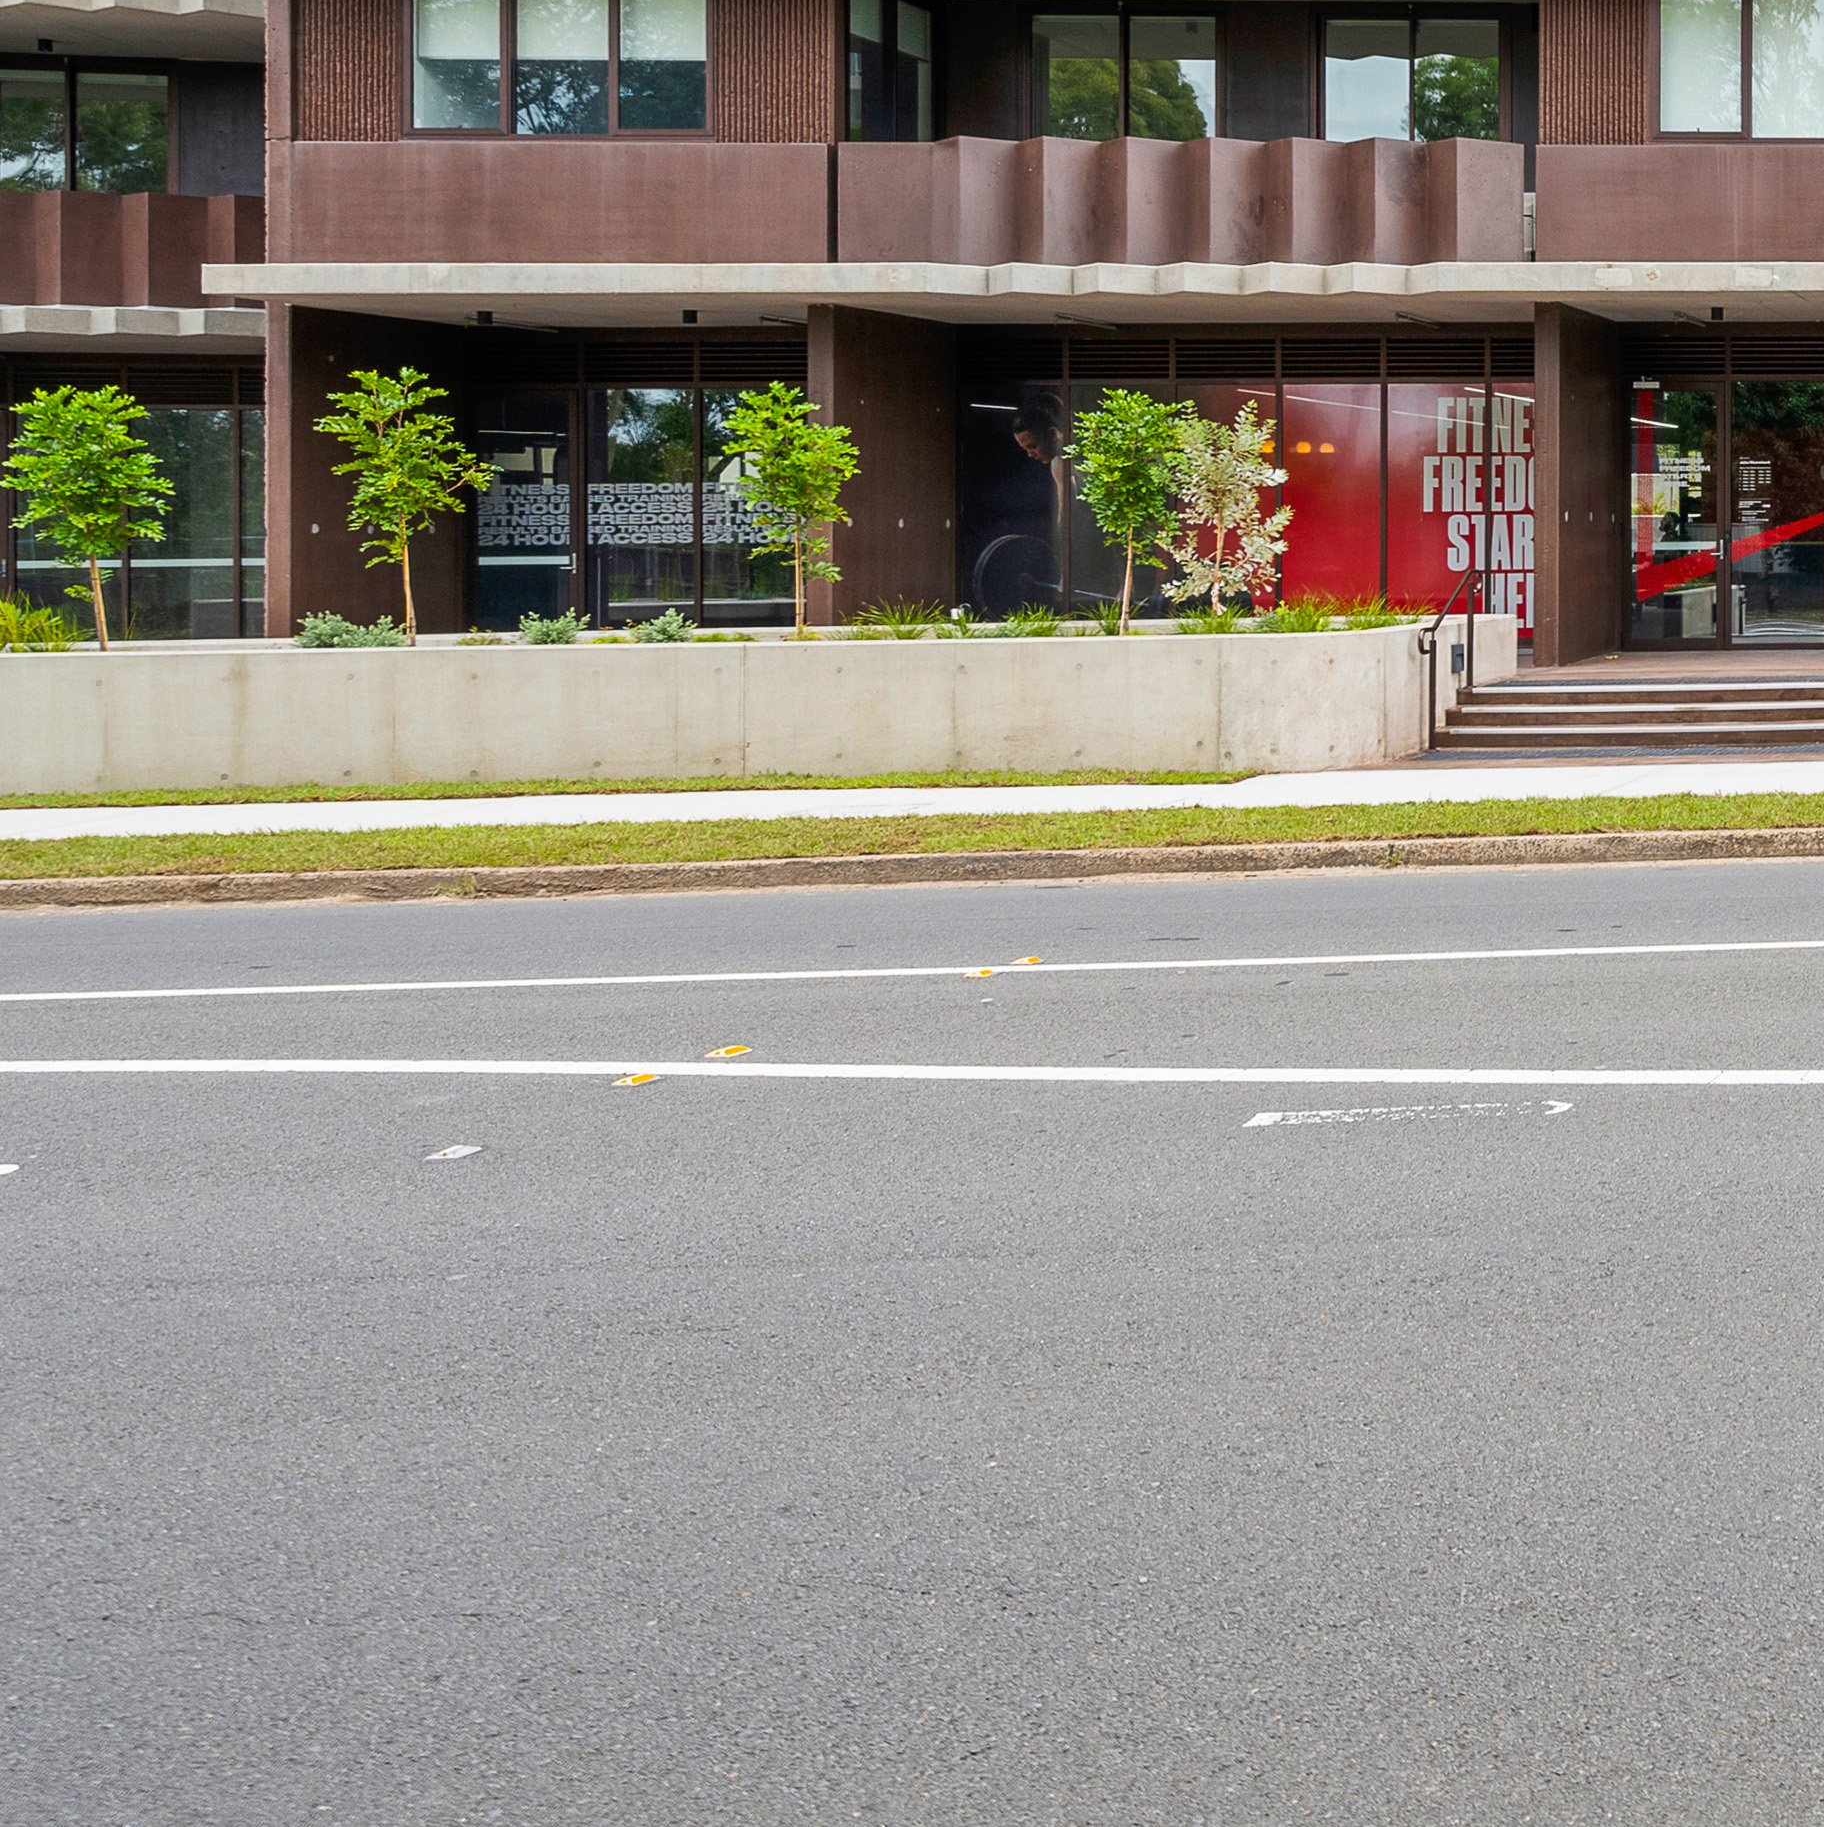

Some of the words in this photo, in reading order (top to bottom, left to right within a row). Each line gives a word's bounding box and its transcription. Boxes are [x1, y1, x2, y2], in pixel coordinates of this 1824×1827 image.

[1437, 397, 1535, 453] FITNE
[588, 483, 693, 494] FREEDOM
[1423, 456, 1535, 512] FREED
[618, 494, 692, 503] TRAINING
[597, 502, 693, 513] ACCESS
[479, 515, 570, 526] FITNESS
[588, 513, 693, 524] FREEDOM
[618, 524, 693, 533] TRAINING
[479, 534, 510, 546] 24
[597, 533, 694, 544] ACCESS
[702, 533, 734, 544] 24
[1447, 514, 1535, 572] STAR
